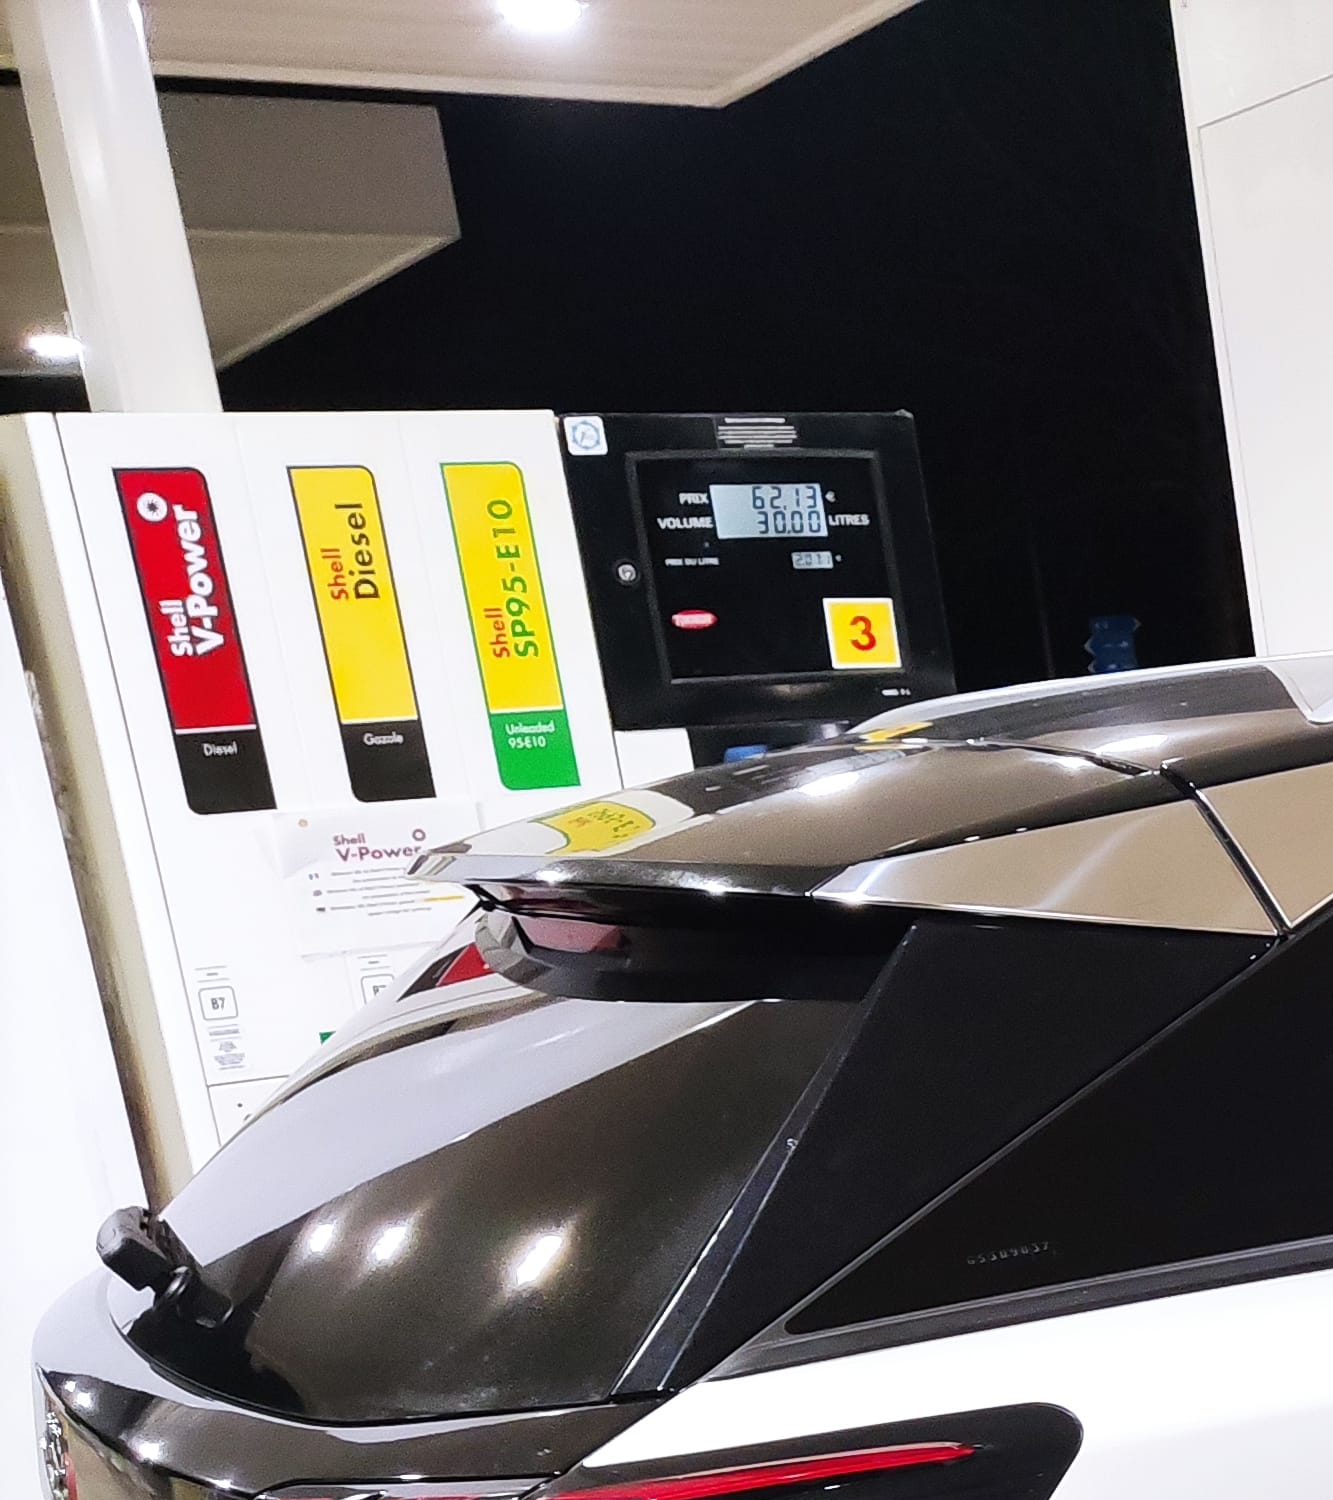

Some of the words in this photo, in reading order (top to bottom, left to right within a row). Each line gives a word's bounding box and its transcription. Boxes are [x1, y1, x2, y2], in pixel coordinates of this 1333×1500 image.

[679, 493, 709, 505] PRIX
[657, 517, 714, 530] VOLUME
[828, 514, 870, 526] LITRES
[334, 503, 380, 600] Diesel
[172, 503, 226, 656] V-Power
[320, 547, 350, 600] Shell
[159, 599, 194, 657] Shell
[483, 607, 511, 658] Shell
[849, 615, 877, 651] 3
[332, 833, 366, 847] Shell
[210, 996, 226, 1011] B7
